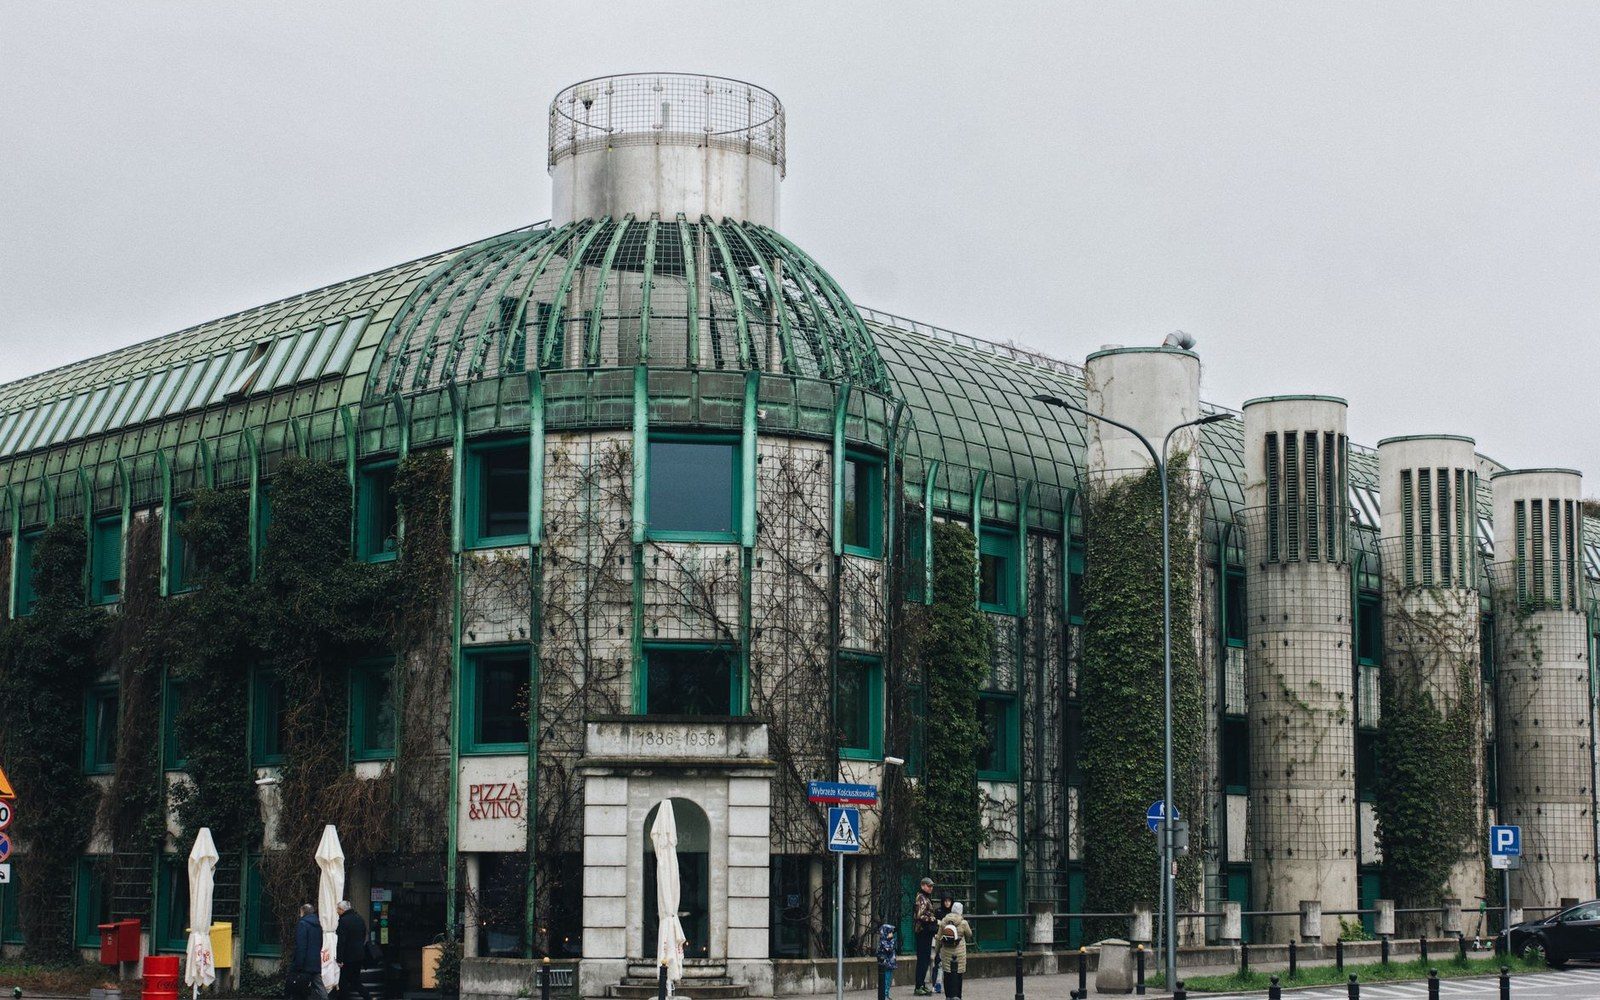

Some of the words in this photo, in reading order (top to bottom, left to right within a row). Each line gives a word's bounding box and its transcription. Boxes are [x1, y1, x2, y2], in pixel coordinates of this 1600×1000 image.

[469, 783, 521, 801] PIZZA
[811, 786, 836, 797] Wybrzeże
[469, 800, 520, 820] &VINO
[1497, 829, 1514, 852] P
